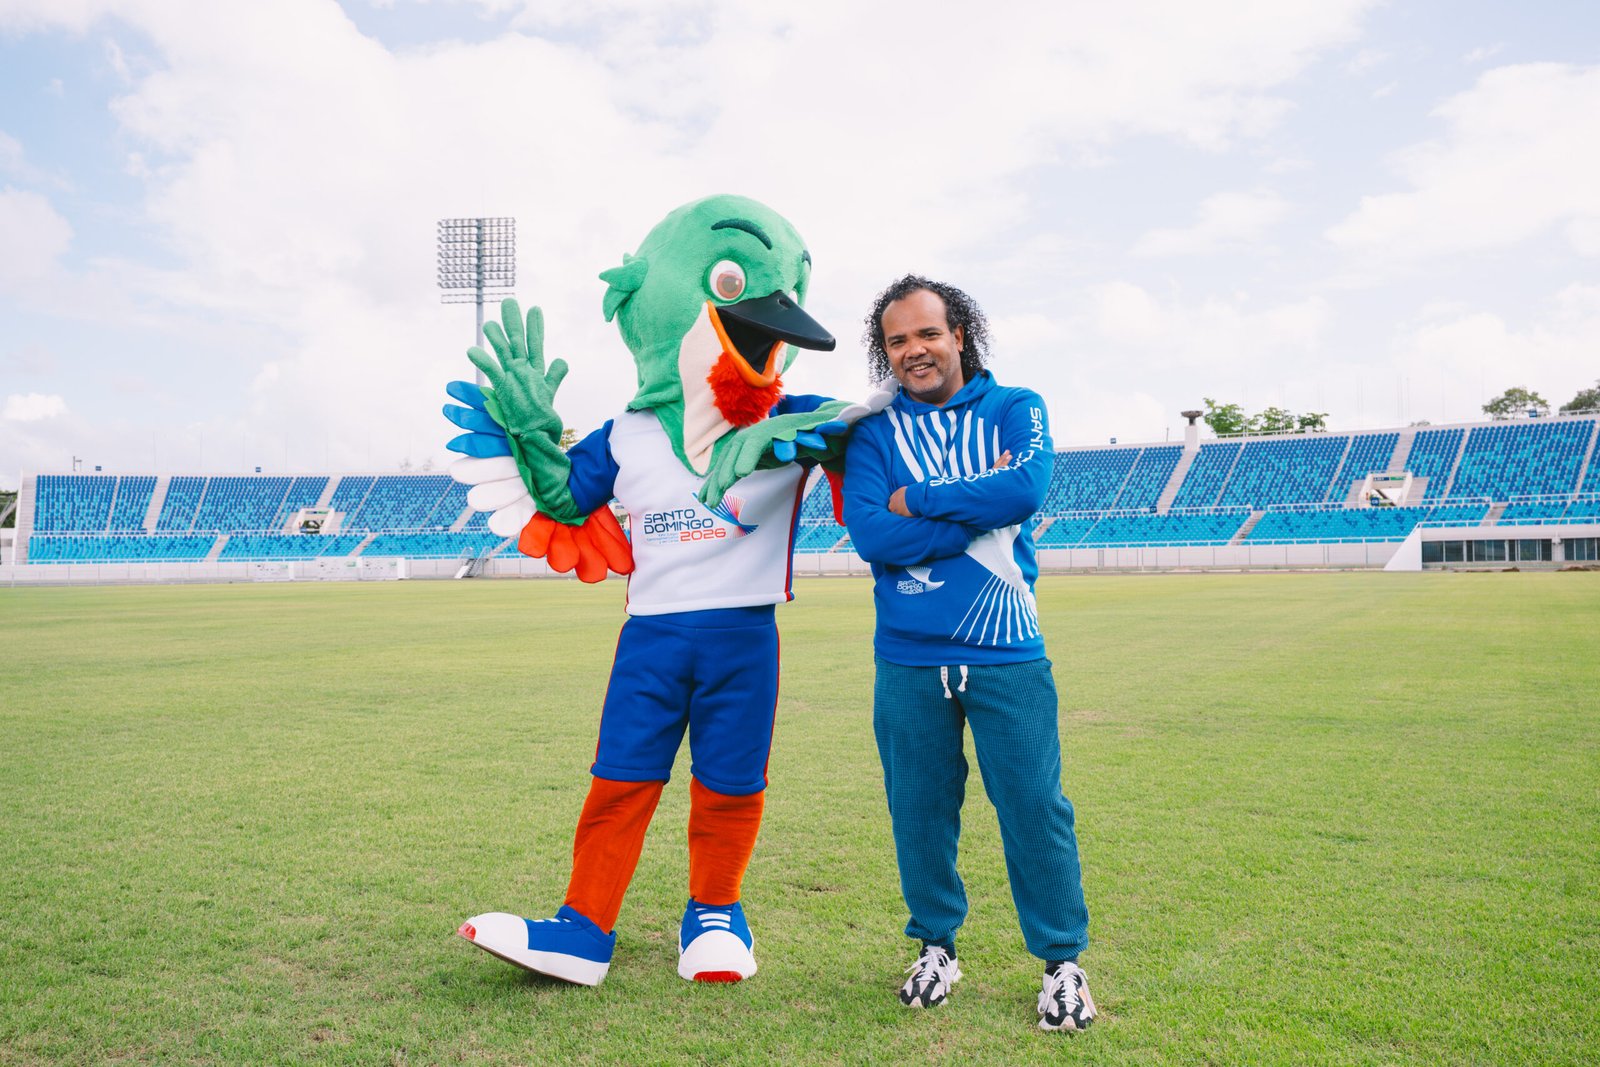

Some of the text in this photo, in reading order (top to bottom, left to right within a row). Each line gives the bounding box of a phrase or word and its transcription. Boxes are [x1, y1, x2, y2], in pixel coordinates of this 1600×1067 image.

[644, 509, 696, 523] SANTO
[644, 518, 714, 534] DOMINGO
[680, 528, 726, 541] 2026
